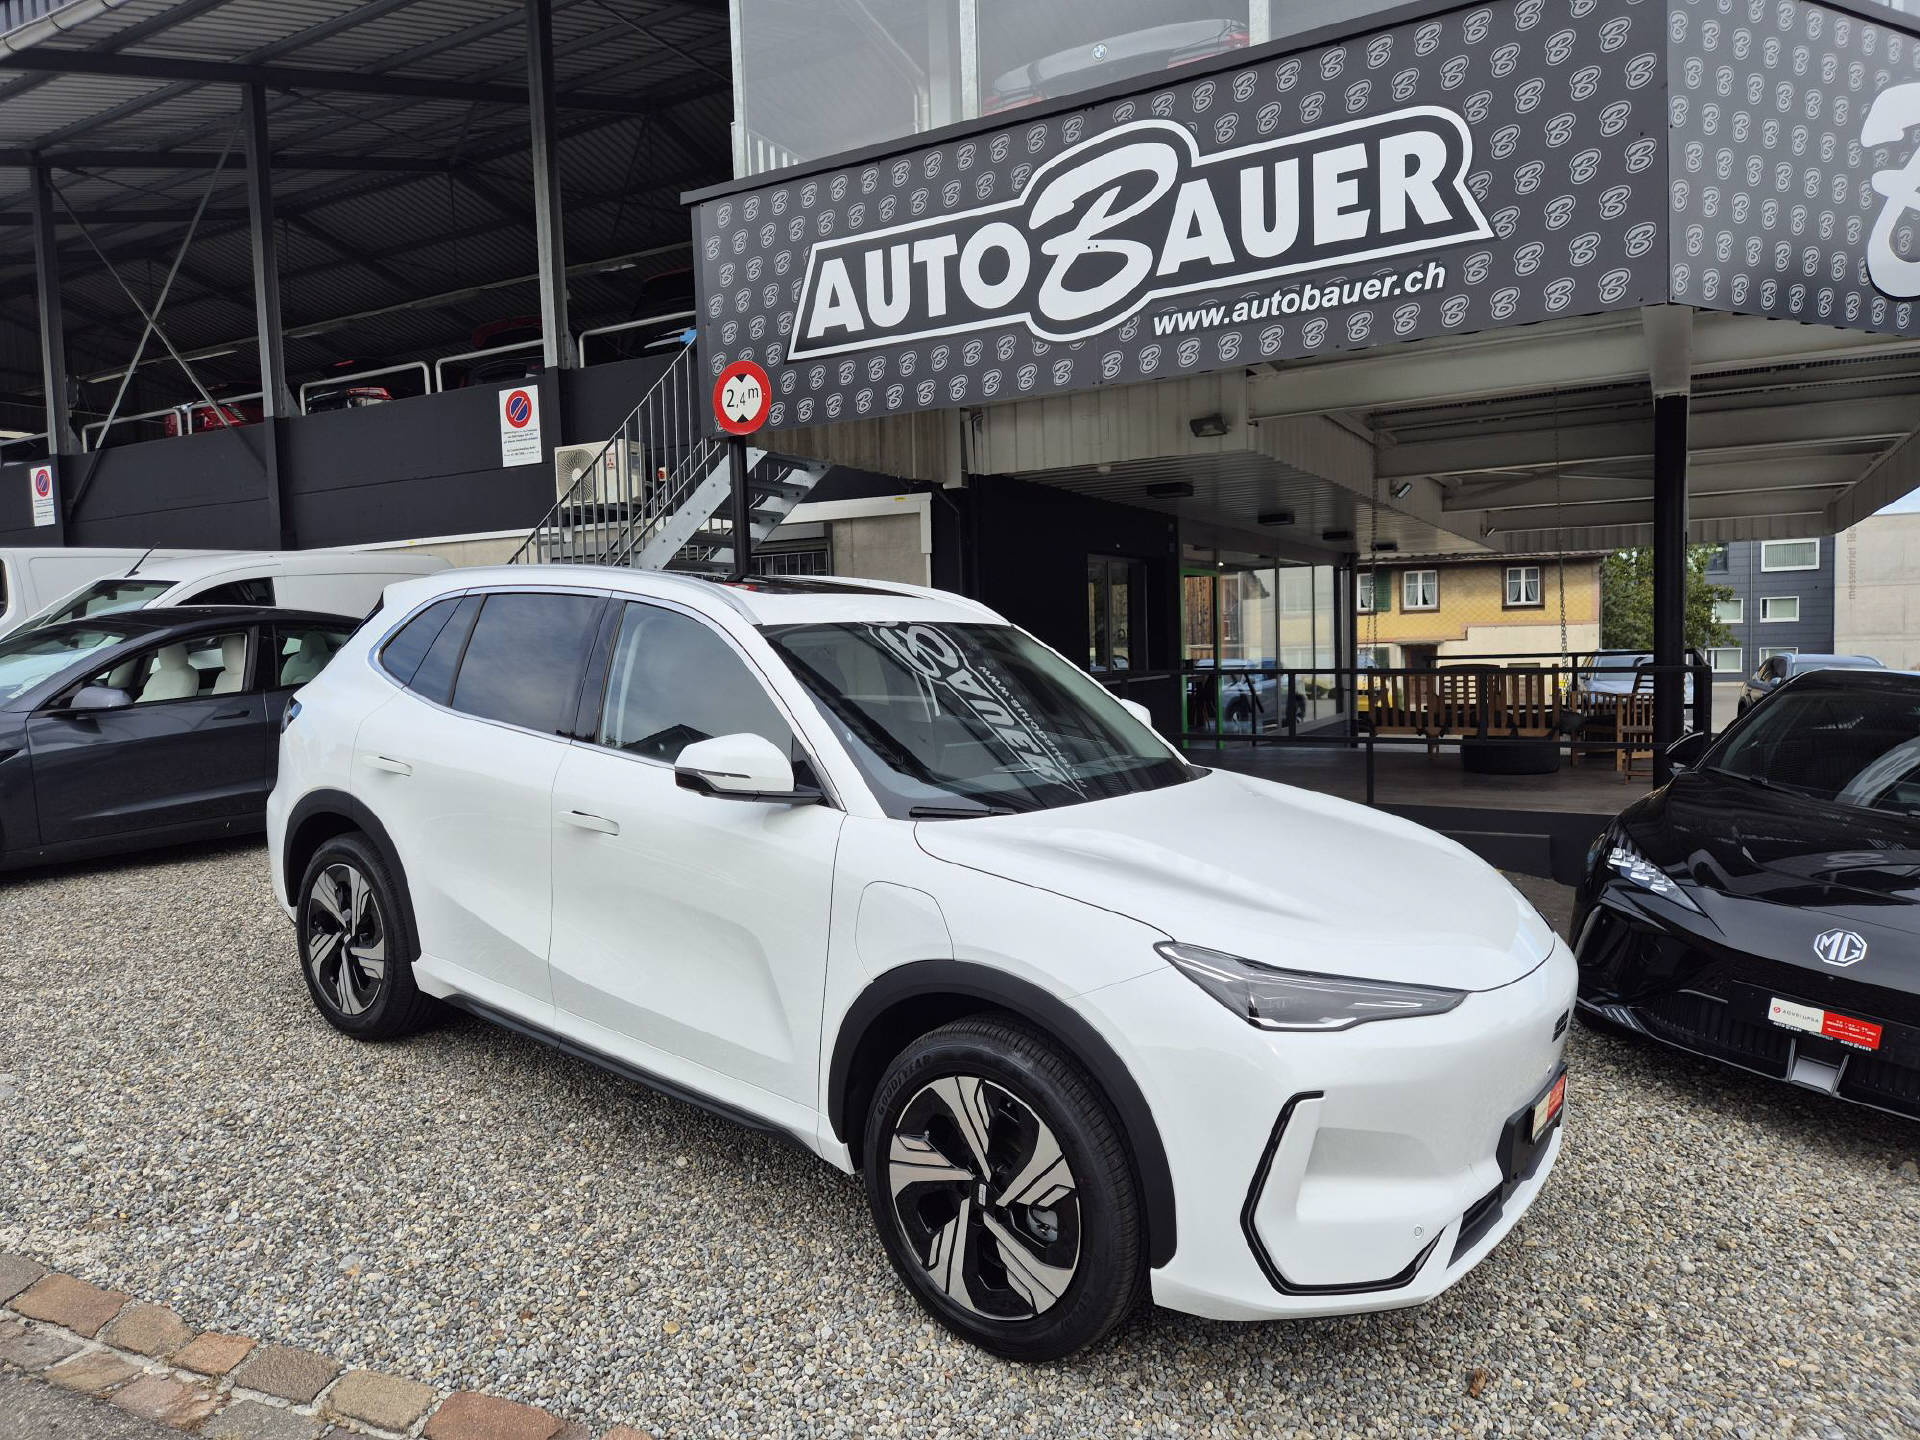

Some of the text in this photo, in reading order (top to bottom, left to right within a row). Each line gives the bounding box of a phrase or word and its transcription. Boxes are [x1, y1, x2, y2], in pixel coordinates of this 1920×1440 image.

[806, 131, 1452, 338] AUTO BAUER
[1153, 262, 1446, 337] www.autobauer.ch
[1820, 931, 1864, 962] MG
